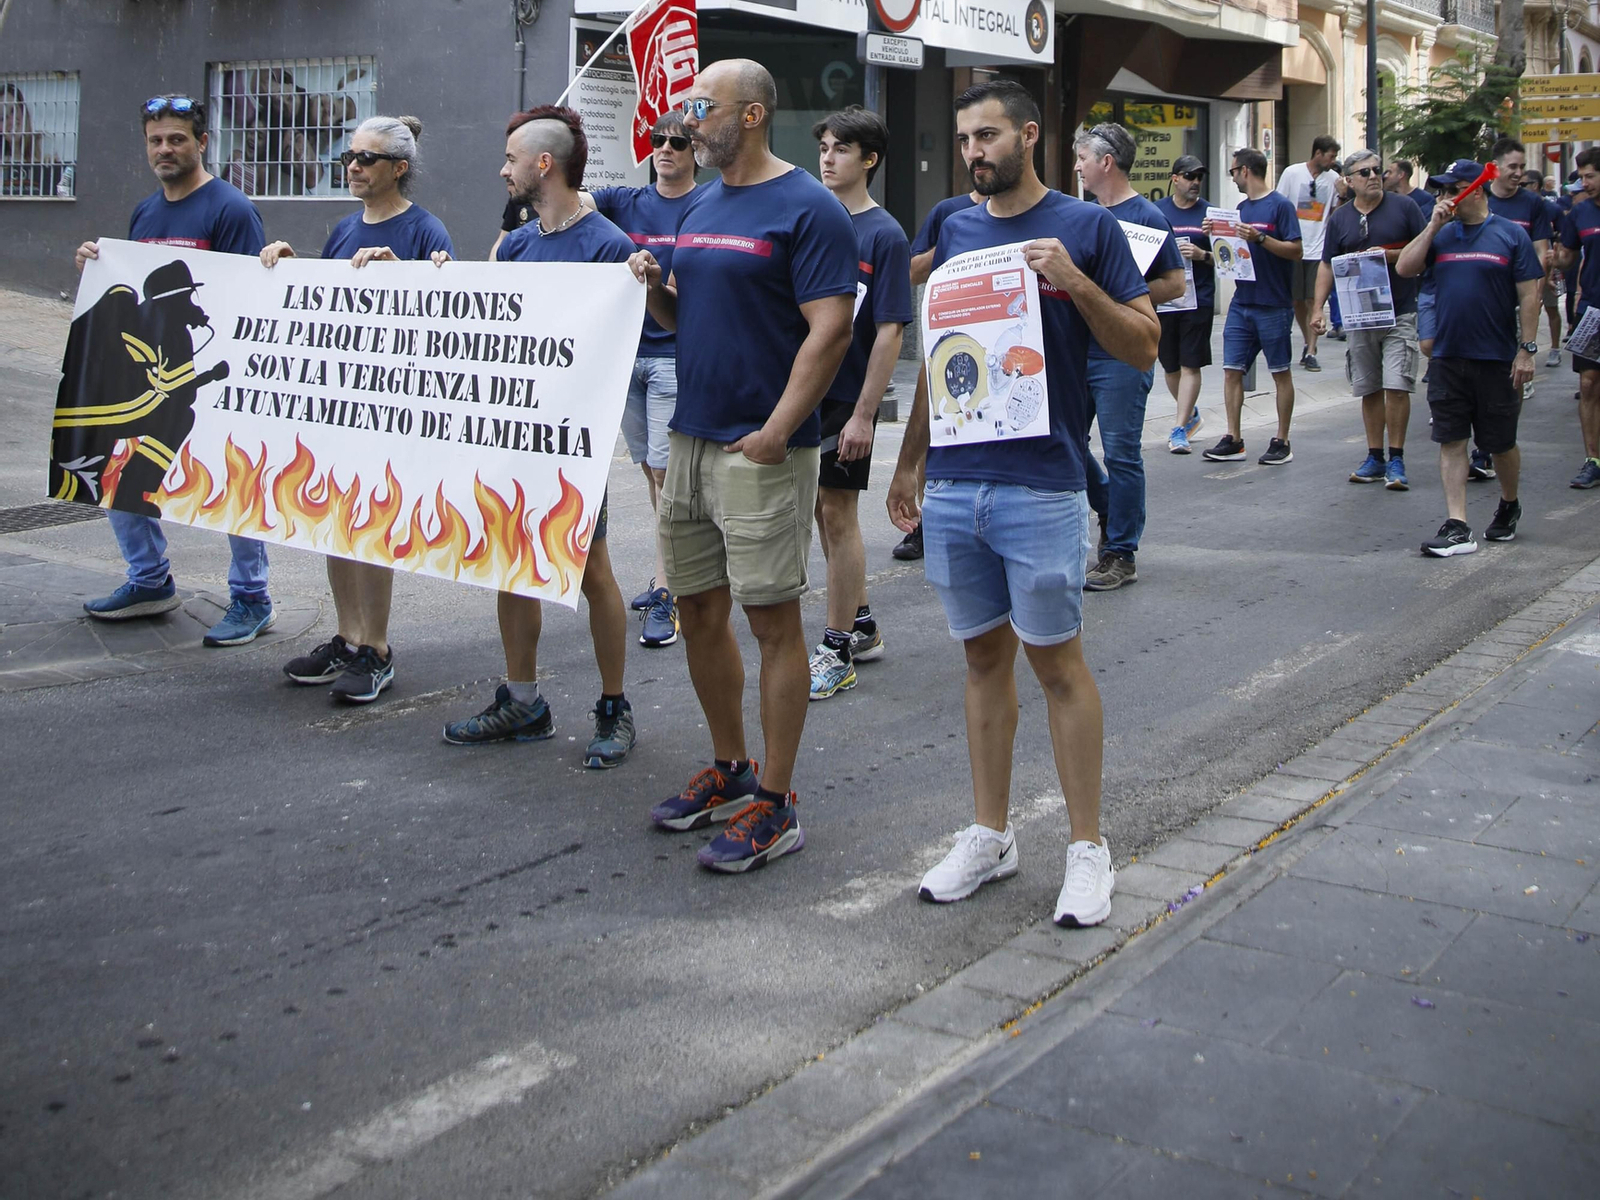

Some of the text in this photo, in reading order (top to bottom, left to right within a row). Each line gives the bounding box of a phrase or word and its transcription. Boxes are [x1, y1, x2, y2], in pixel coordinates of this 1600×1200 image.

[884, 38, 908, 46] EXCEPTO
[871, 52, 919, 64] ENTRADA GARAJE
[576, 68, 621, 80] PRTOCARRERO
[721, 238, 755, 249] BOMBEROS
[984, 256, 1012, 267] CALIDAD
[932, 289, 938, 300] 5
[282, 284, 523, 322] LAS INSTALACIONES
[232, 316, 574, 368] DEL PARQUE DE BOMBEROS
[244, 353, 540, 409] SON LA VERGÜENZA DEL
[213, 386, 592, 458] AYUNTAMIENTO DE ALMERÍA
